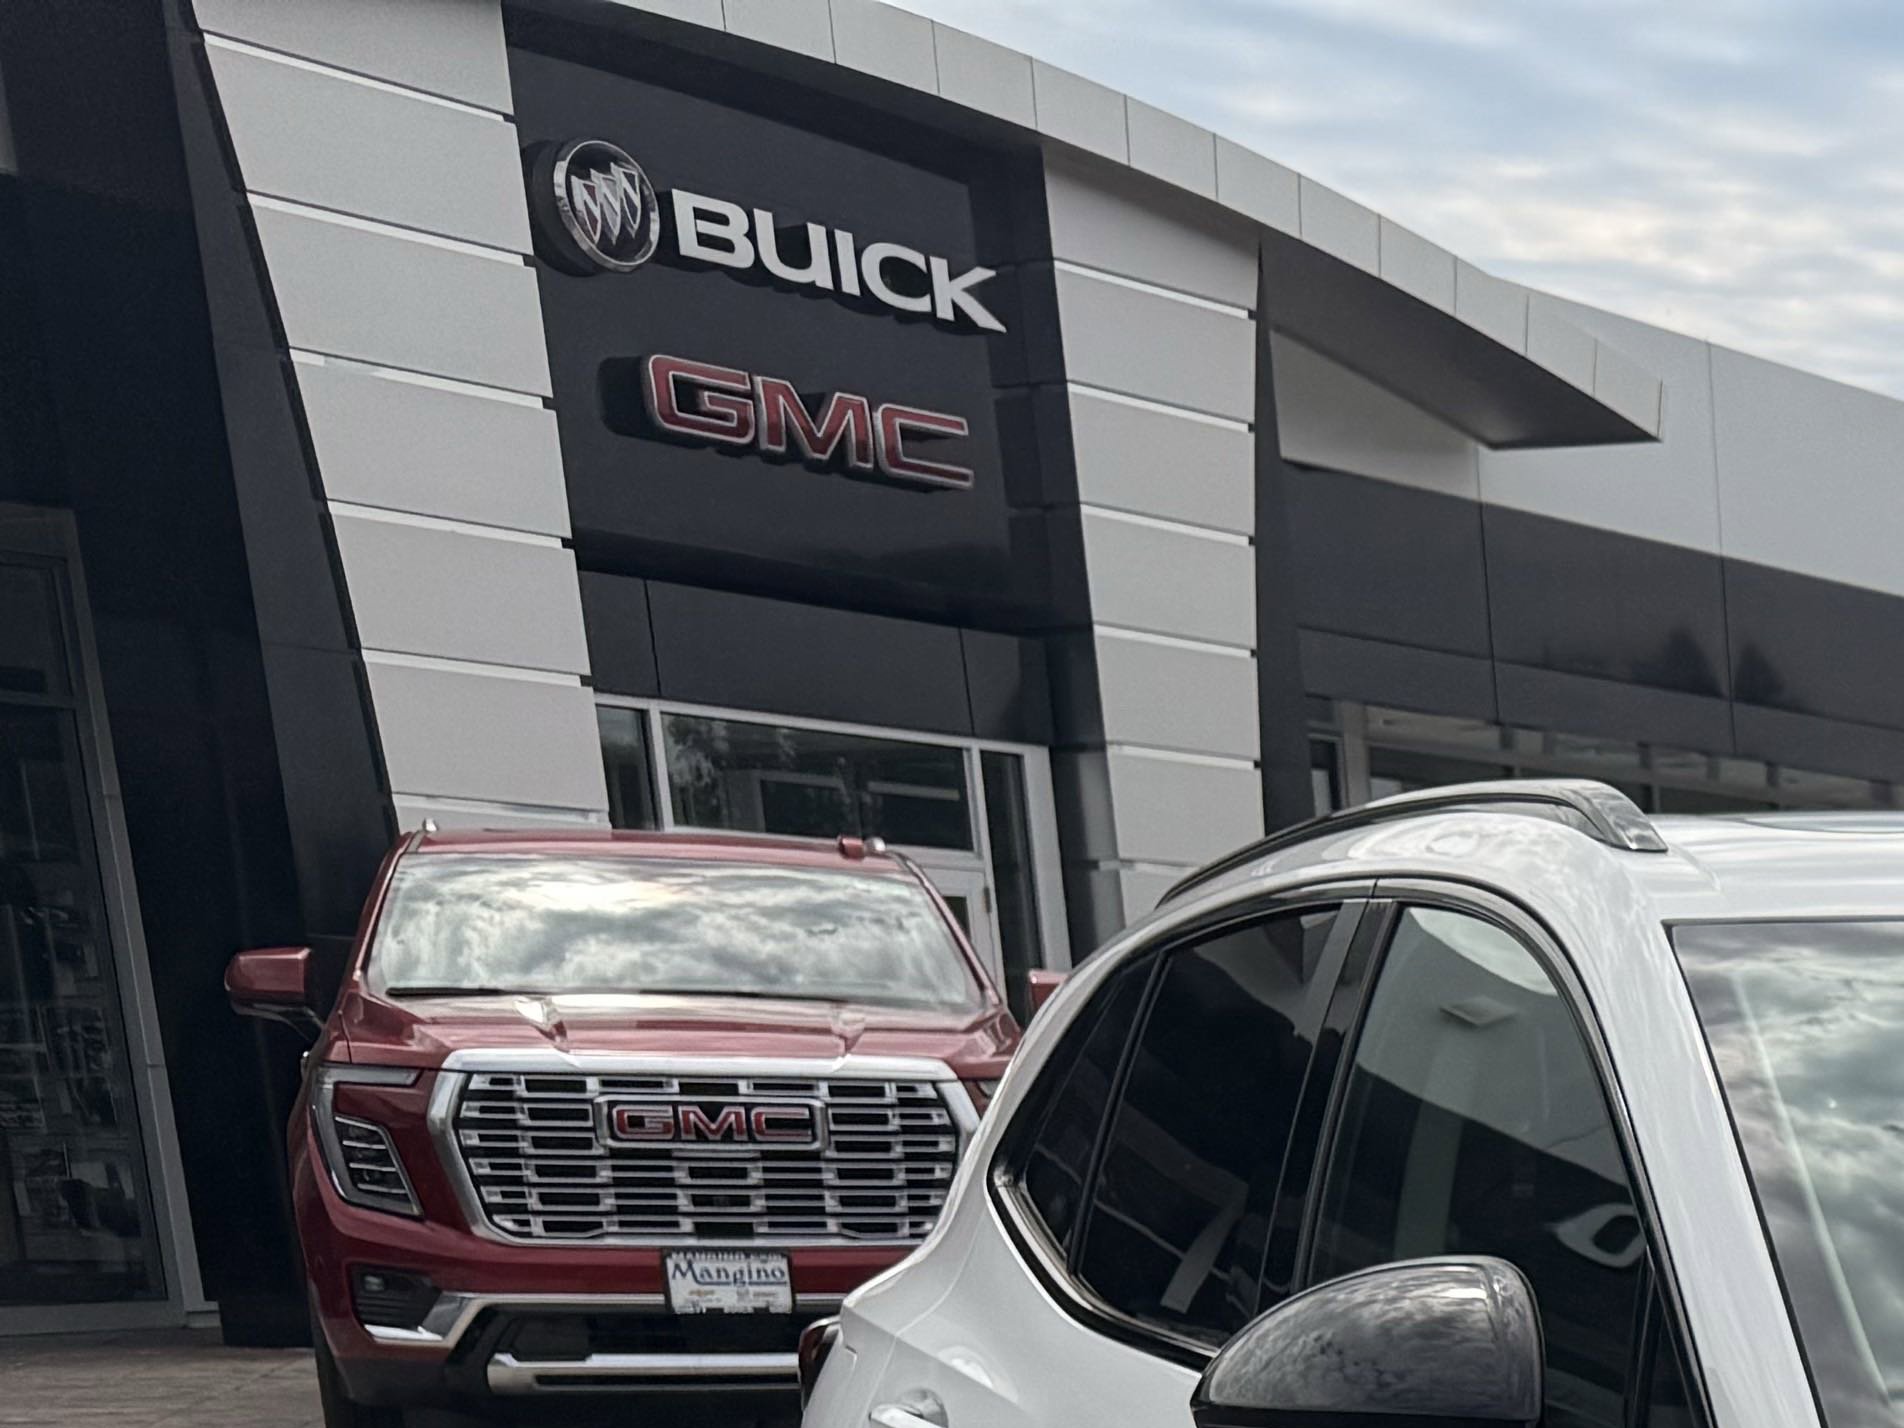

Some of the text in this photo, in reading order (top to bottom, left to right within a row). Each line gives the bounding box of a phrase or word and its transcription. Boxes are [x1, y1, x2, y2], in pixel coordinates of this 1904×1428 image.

[671, 187, 1007, 334] BUICK
[645, 353, 974, 490] GMC
[612, 1103, 813, 1143] GMC
[671, 1259, 788, 1287] Mangino
